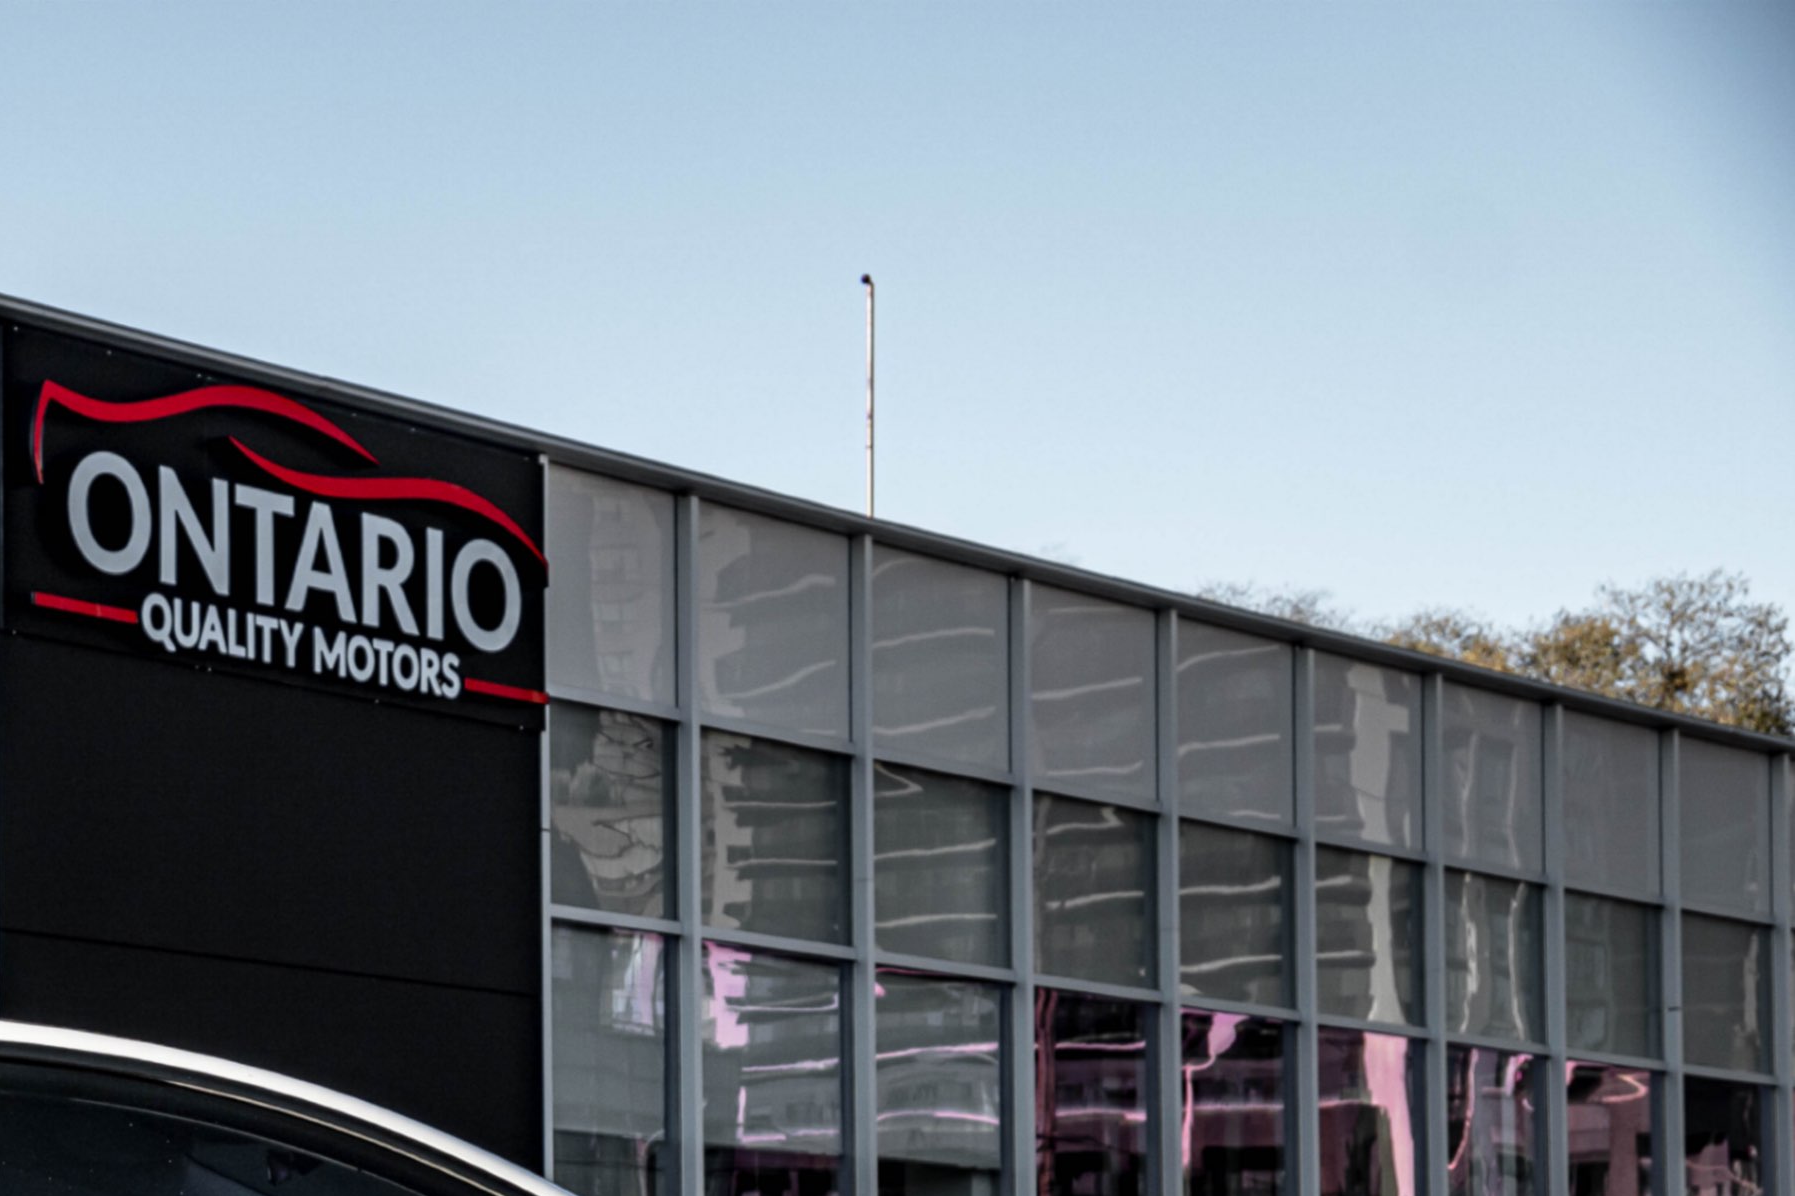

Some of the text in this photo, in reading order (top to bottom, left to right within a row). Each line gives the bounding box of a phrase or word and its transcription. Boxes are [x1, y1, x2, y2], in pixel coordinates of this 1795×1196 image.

[67, 450, 522, 653] ONTARIO
[141, 592, 461, 699] QUALITY MOTORS
